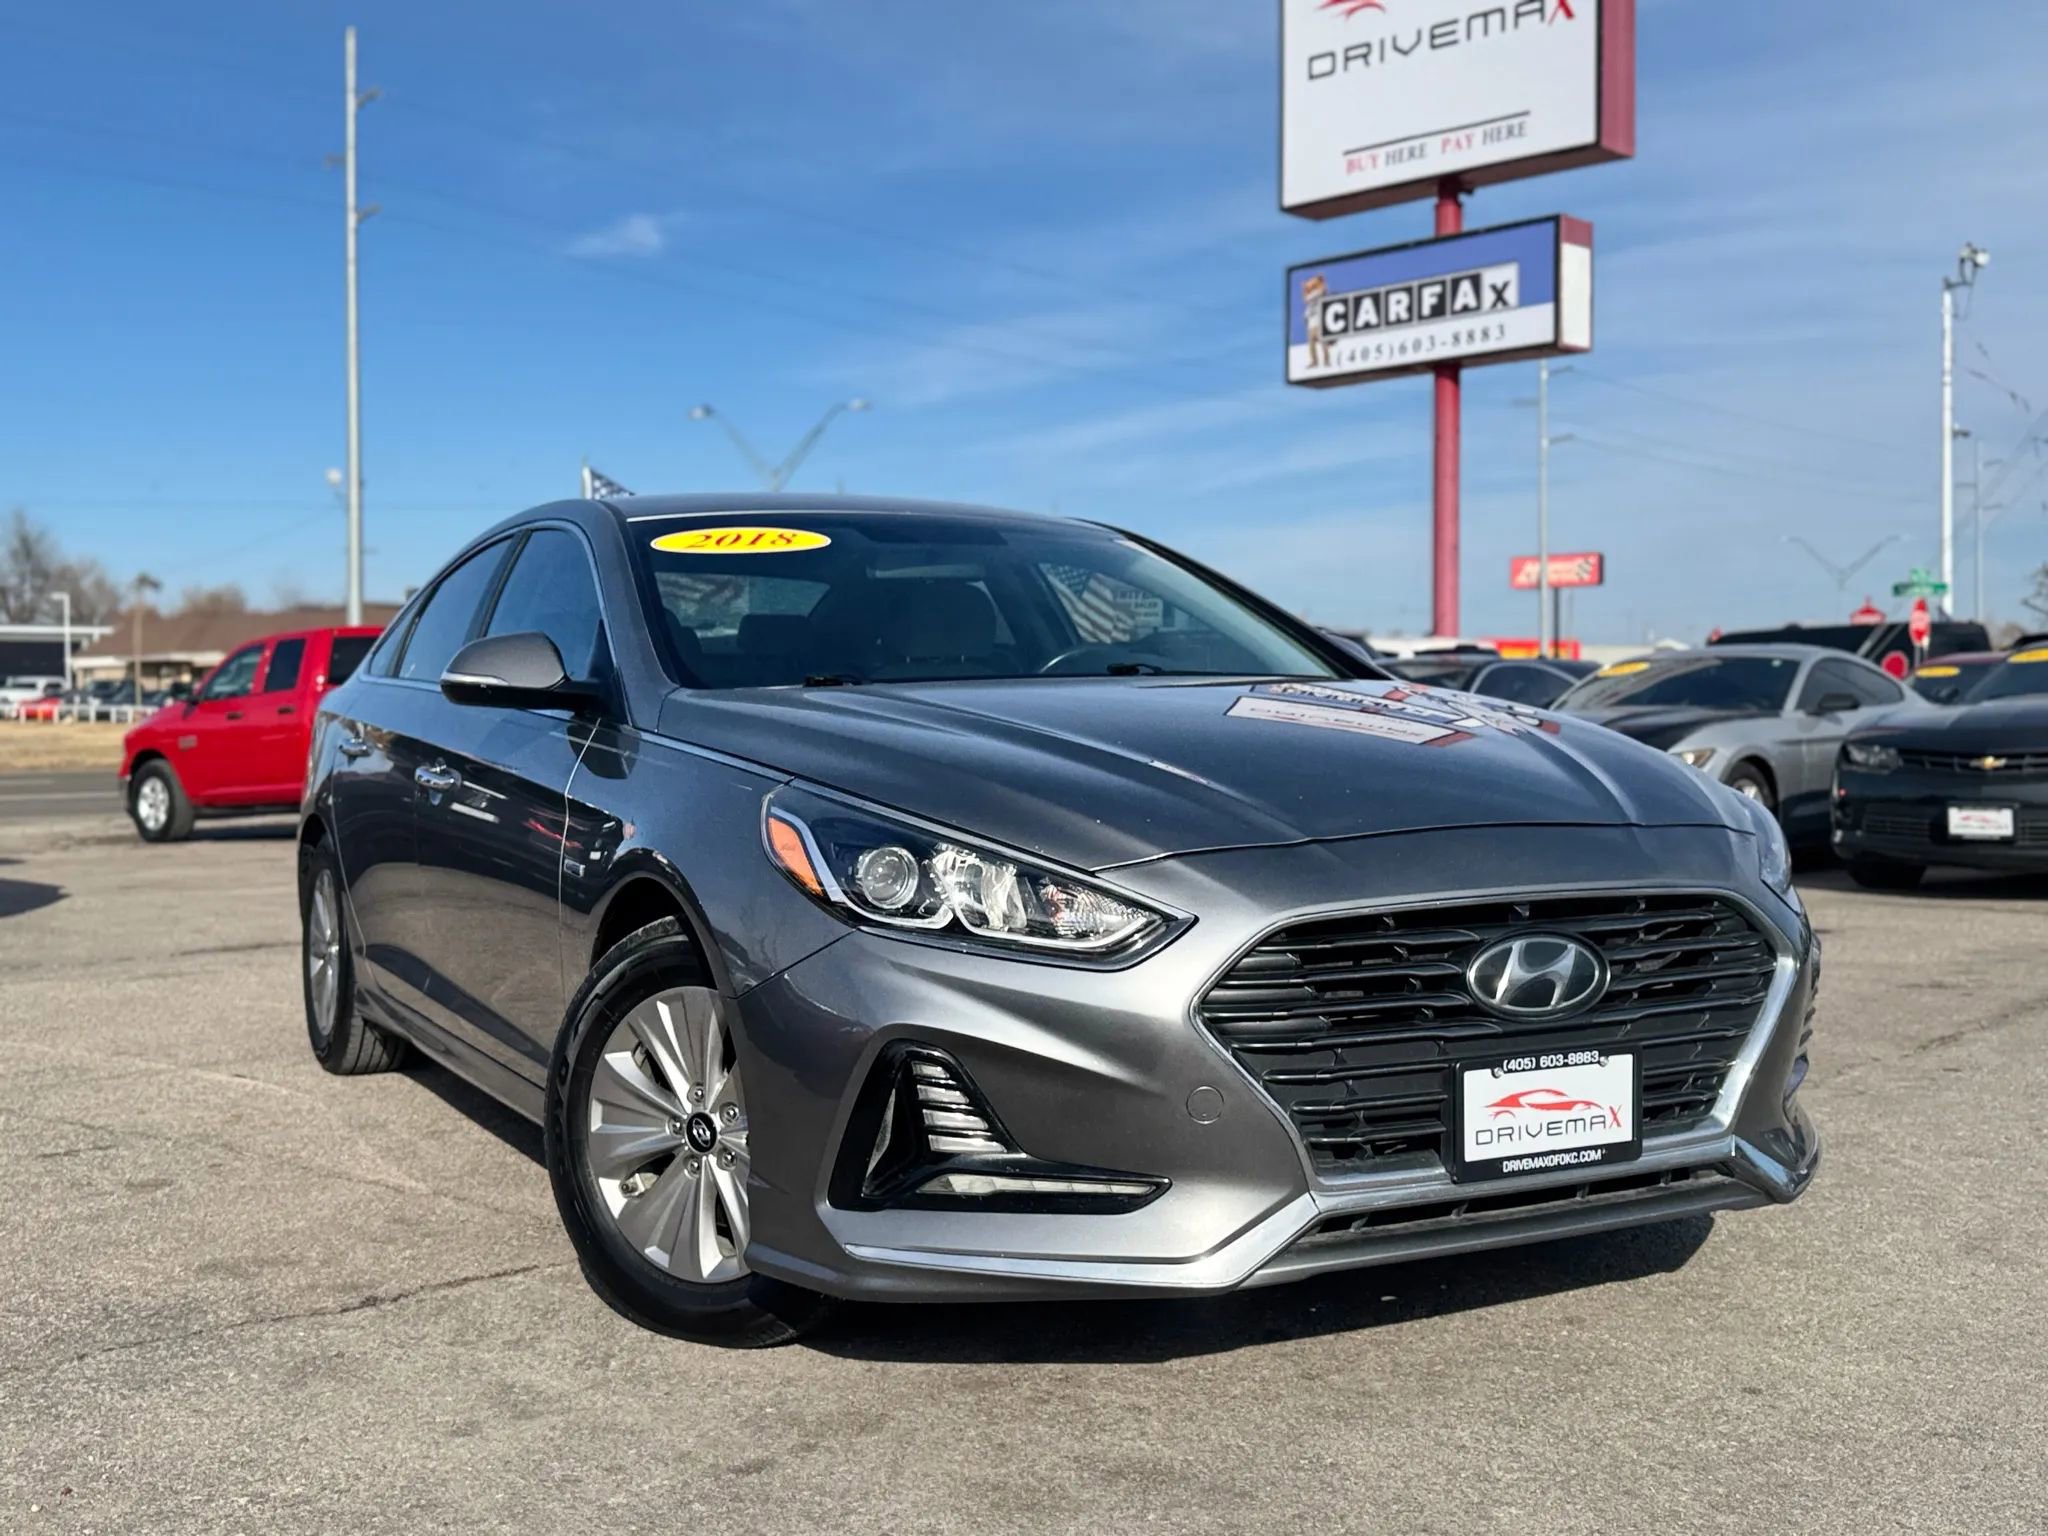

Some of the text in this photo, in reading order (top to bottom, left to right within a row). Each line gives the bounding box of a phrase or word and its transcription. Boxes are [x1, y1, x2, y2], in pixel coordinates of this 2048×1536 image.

[1346, 120, 1528, 175] BUY HERE PAY HERE
[1324, 277, 1512, 334] CARFAX
[686, 532, 798, 548] 2018
[1503, 1050, 1600, 1072] (405) 603-8883
[1475, 1104, 1623, 1146] DRIVEMAX
